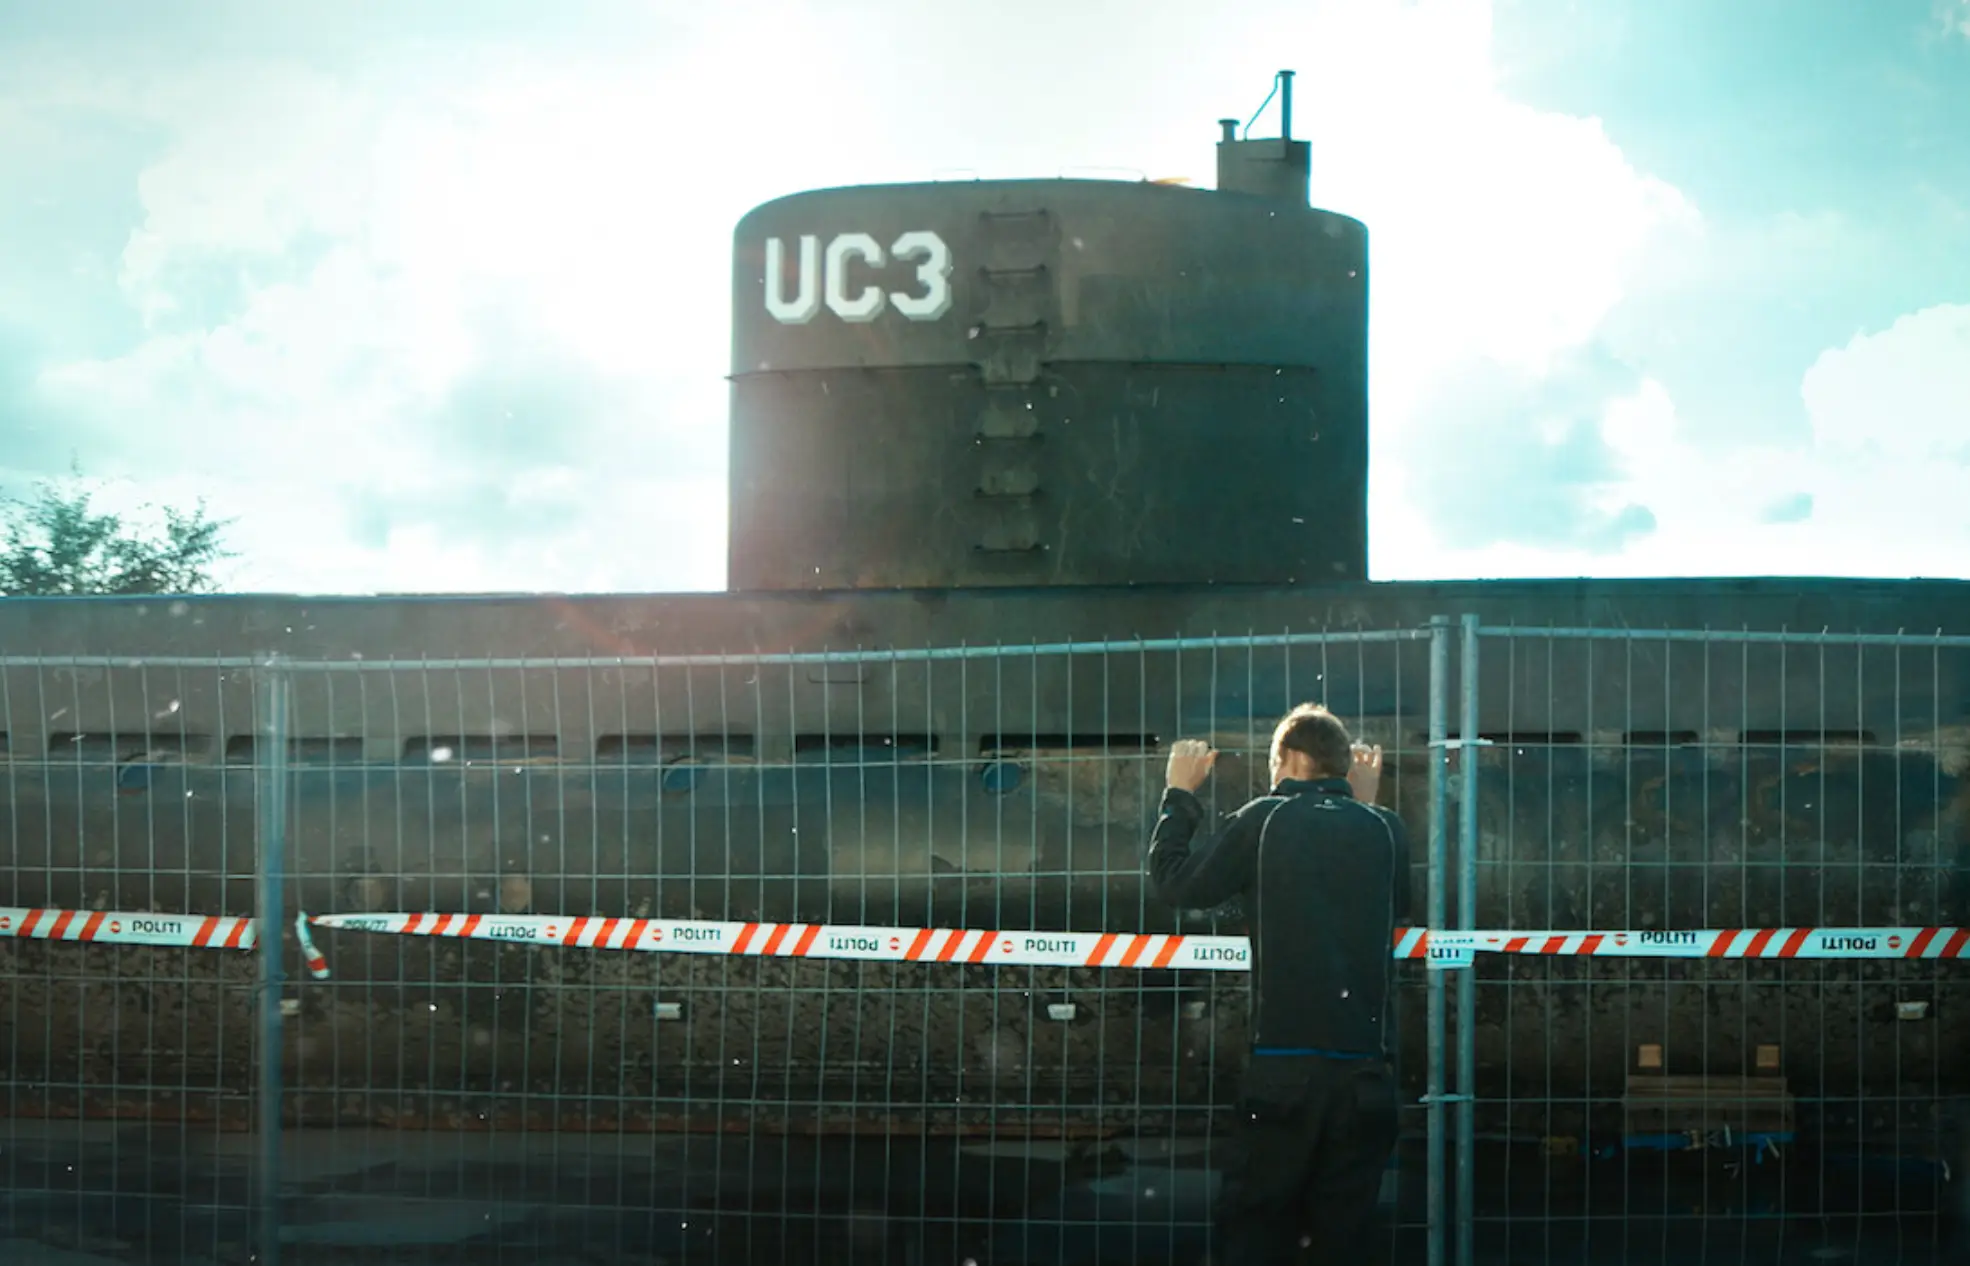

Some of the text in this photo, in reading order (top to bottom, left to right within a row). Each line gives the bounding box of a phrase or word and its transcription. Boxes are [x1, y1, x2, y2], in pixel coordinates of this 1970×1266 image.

[765, 230, 953, 324] UC3
[132, 919, 181, 934] POLITI
[490, 926, 537, 939] POLITI
[673, 927, 721, 941] POLITI
[1640, 930, 1696, 945] POLITI
[829, 937, 878, 951] POLITI
[1025, 938, 1076, 953] POLITI
[1821, 937, 1877, 950] POLITI
[1193, 948, 1246, 961] POLITI
